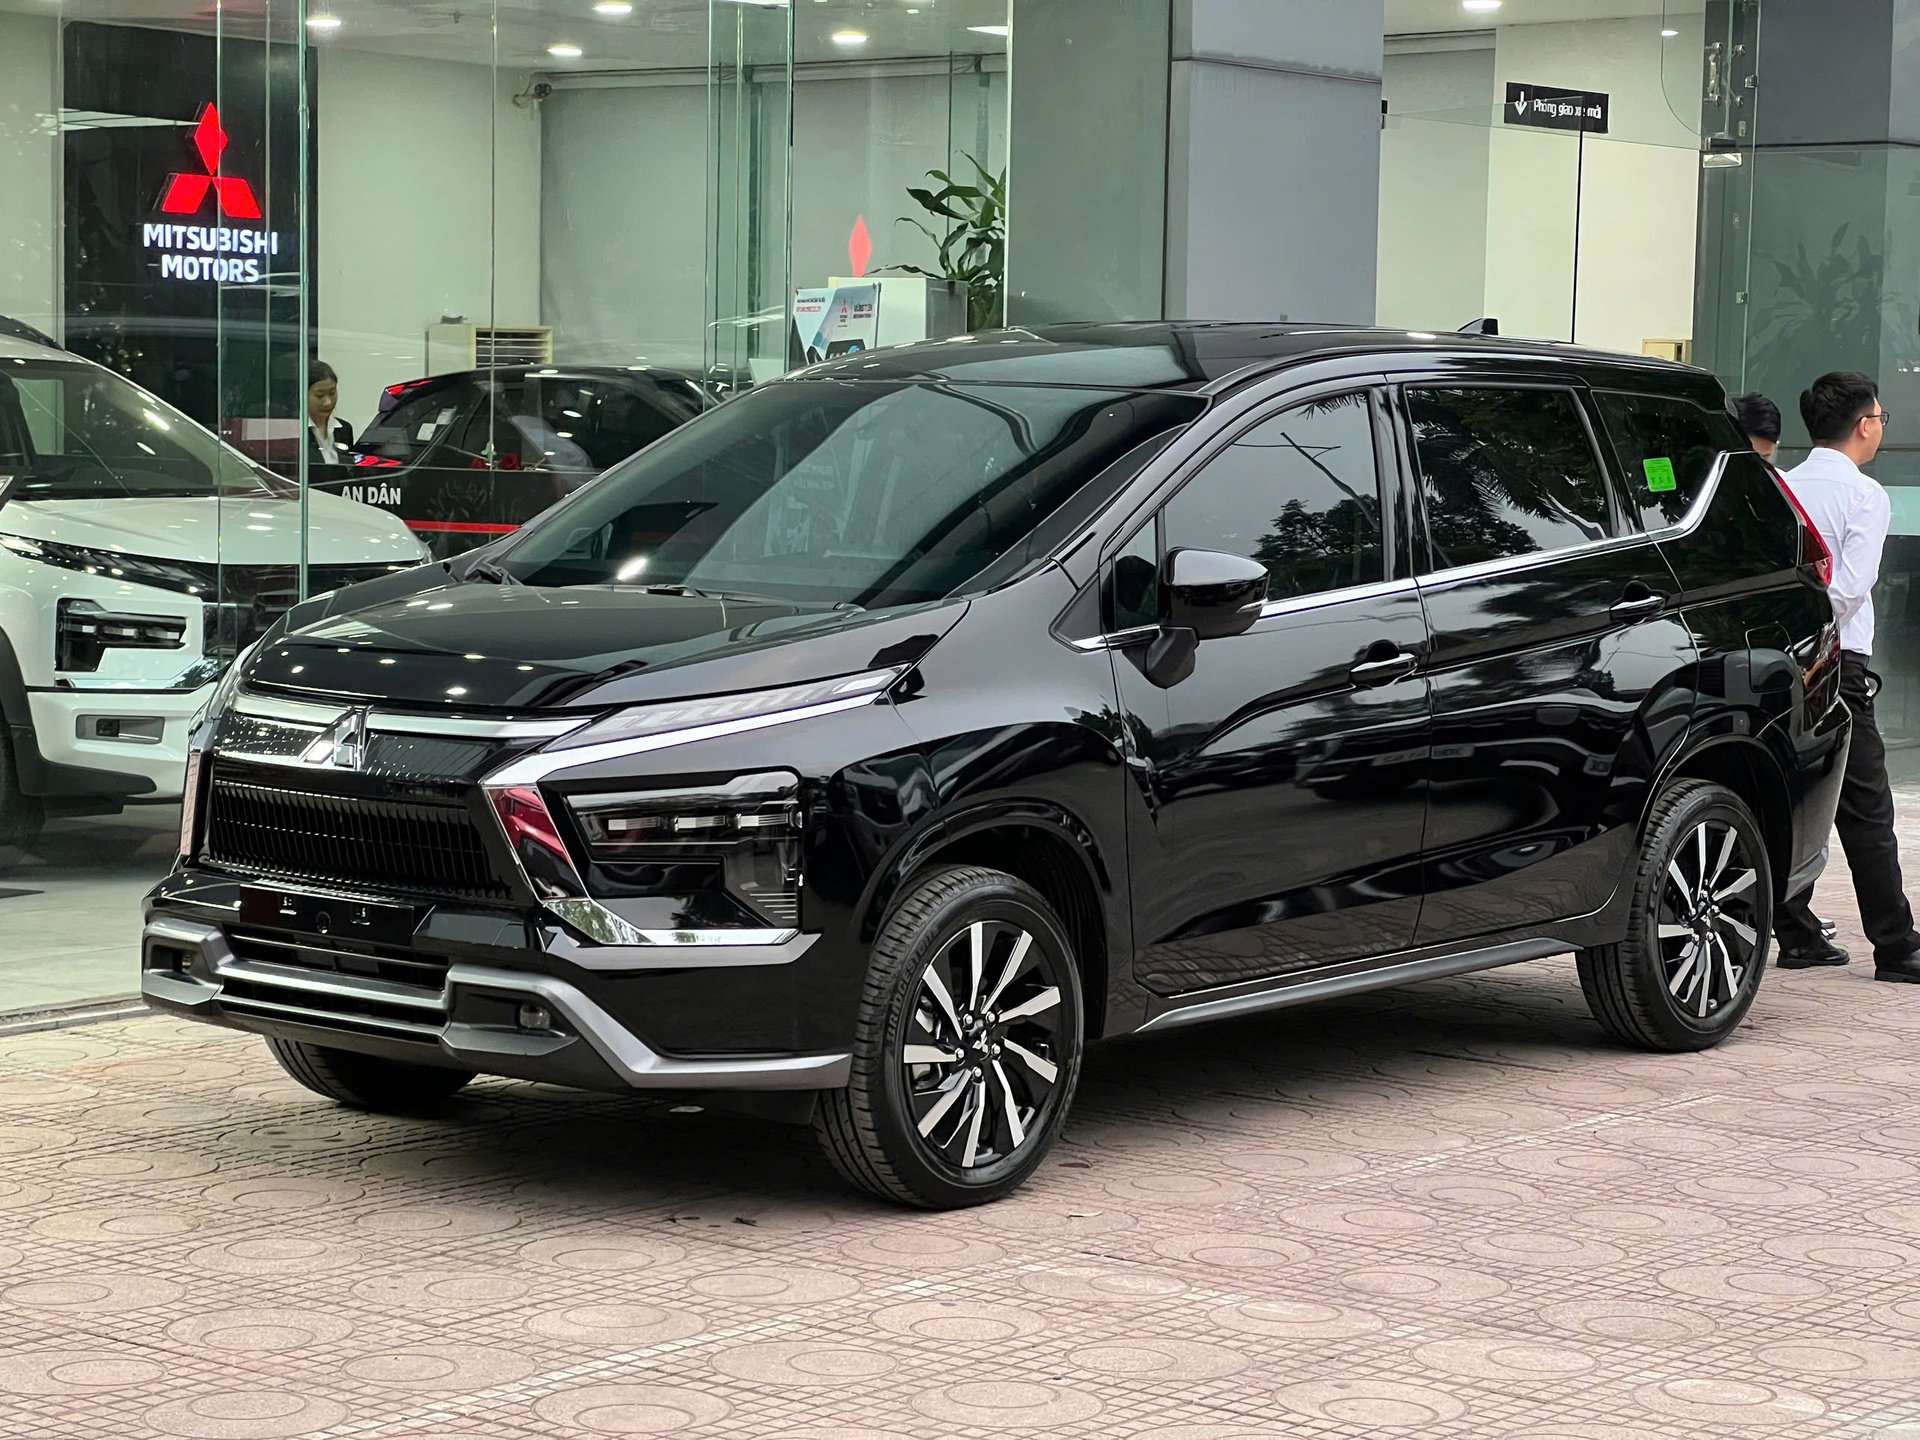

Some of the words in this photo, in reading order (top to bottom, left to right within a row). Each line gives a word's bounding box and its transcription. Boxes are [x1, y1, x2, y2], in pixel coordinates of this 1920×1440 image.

[1558, 103, 1574, 116] giao
[143, 223, 278, 255] MITSUBISHI
[161, 254, 260, 282] MOTORS
[342, 485, 363, 503] AN
[367, 482, 401, 505] DÂN
